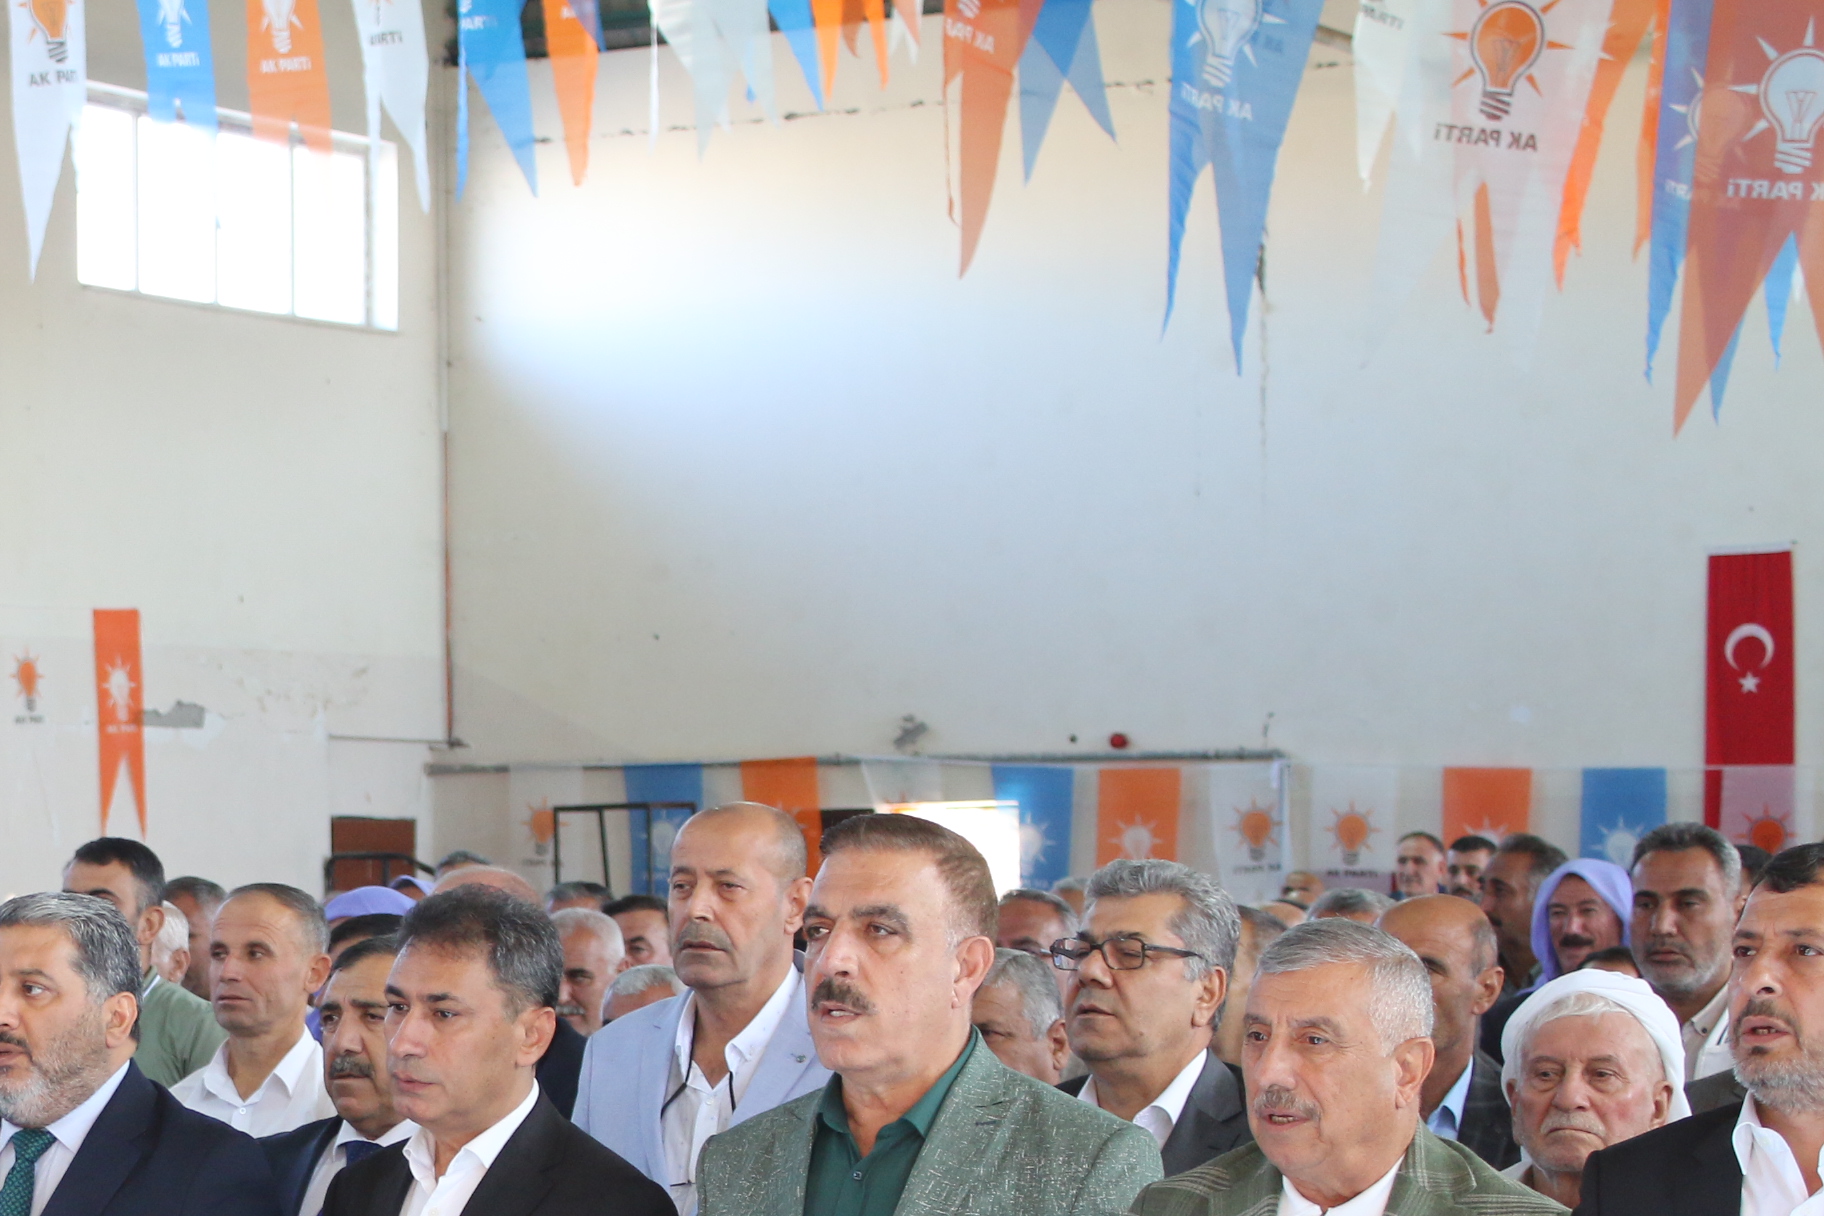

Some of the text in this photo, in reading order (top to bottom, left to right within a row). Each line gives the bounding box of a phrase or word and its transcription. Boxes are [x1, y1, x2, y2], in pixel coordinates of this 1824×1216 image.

[157, 53, 171, 67] AK
[260, 59, 277, 73] AK
[29, 71, 52, 87] AK
